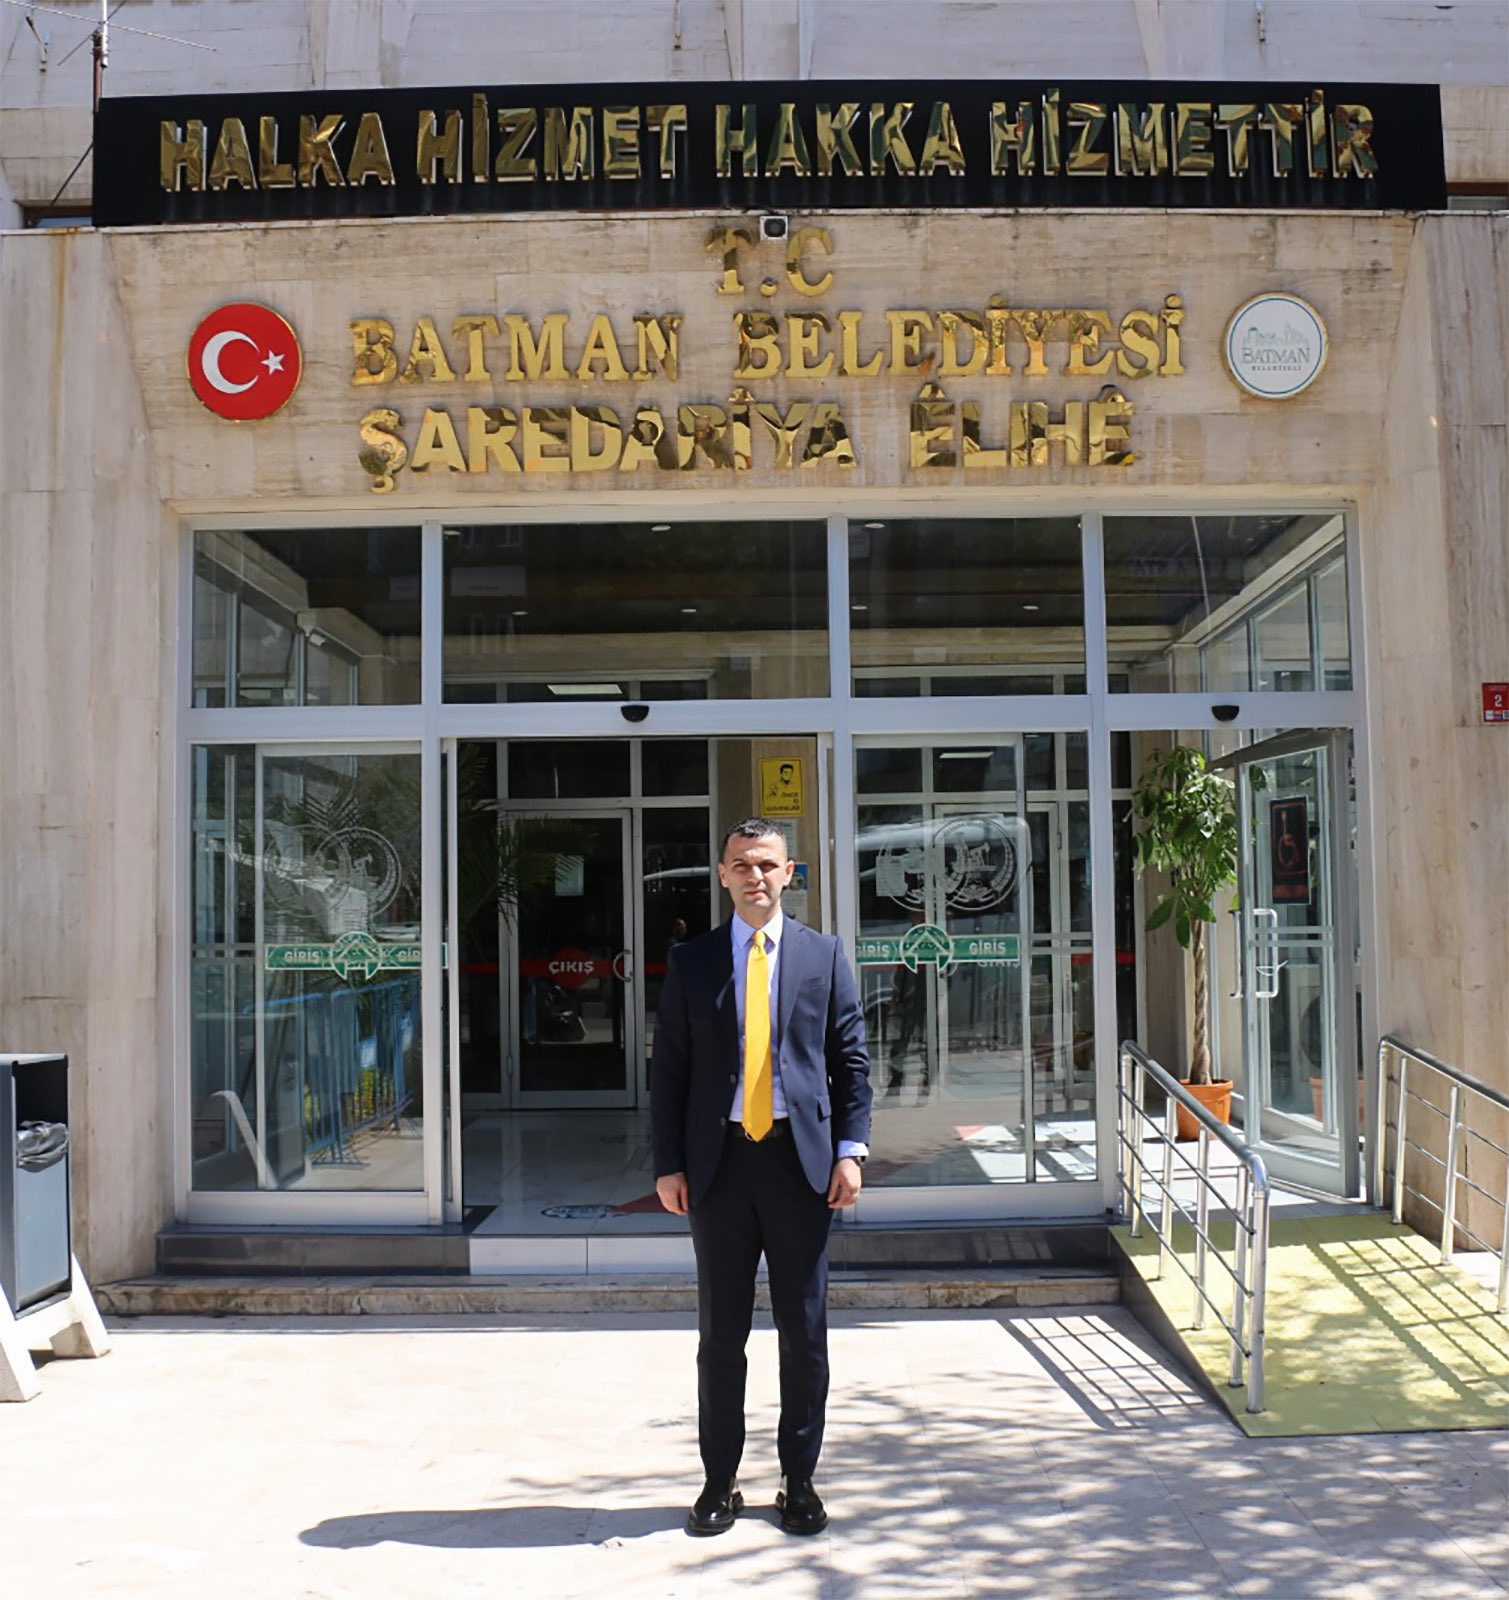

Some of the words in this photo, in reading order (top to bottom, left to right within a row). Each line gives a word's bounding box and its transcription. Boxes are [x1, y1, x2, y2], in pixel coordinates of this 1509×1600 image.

[160, 112, 395, 192] HALKA
[417, 92, 688, 184] HİZMET
[715, 101, 966, 178] HAKKA
[990, 88, 1380, 179] HİZMETTİR
[350, 312, 682, 386] BATMAN
[733, 294, 1186, 380] BELEDİYESİ
[1242, 347, 1310, 364] BATMAN
[359, 386, 857, 493] ŞAREDARÎYA
[1494, 694, 1503, 707] 2
[398, 947, 422, 963] GİR
[548, 961, 594, 975] ÇIKIŞ
